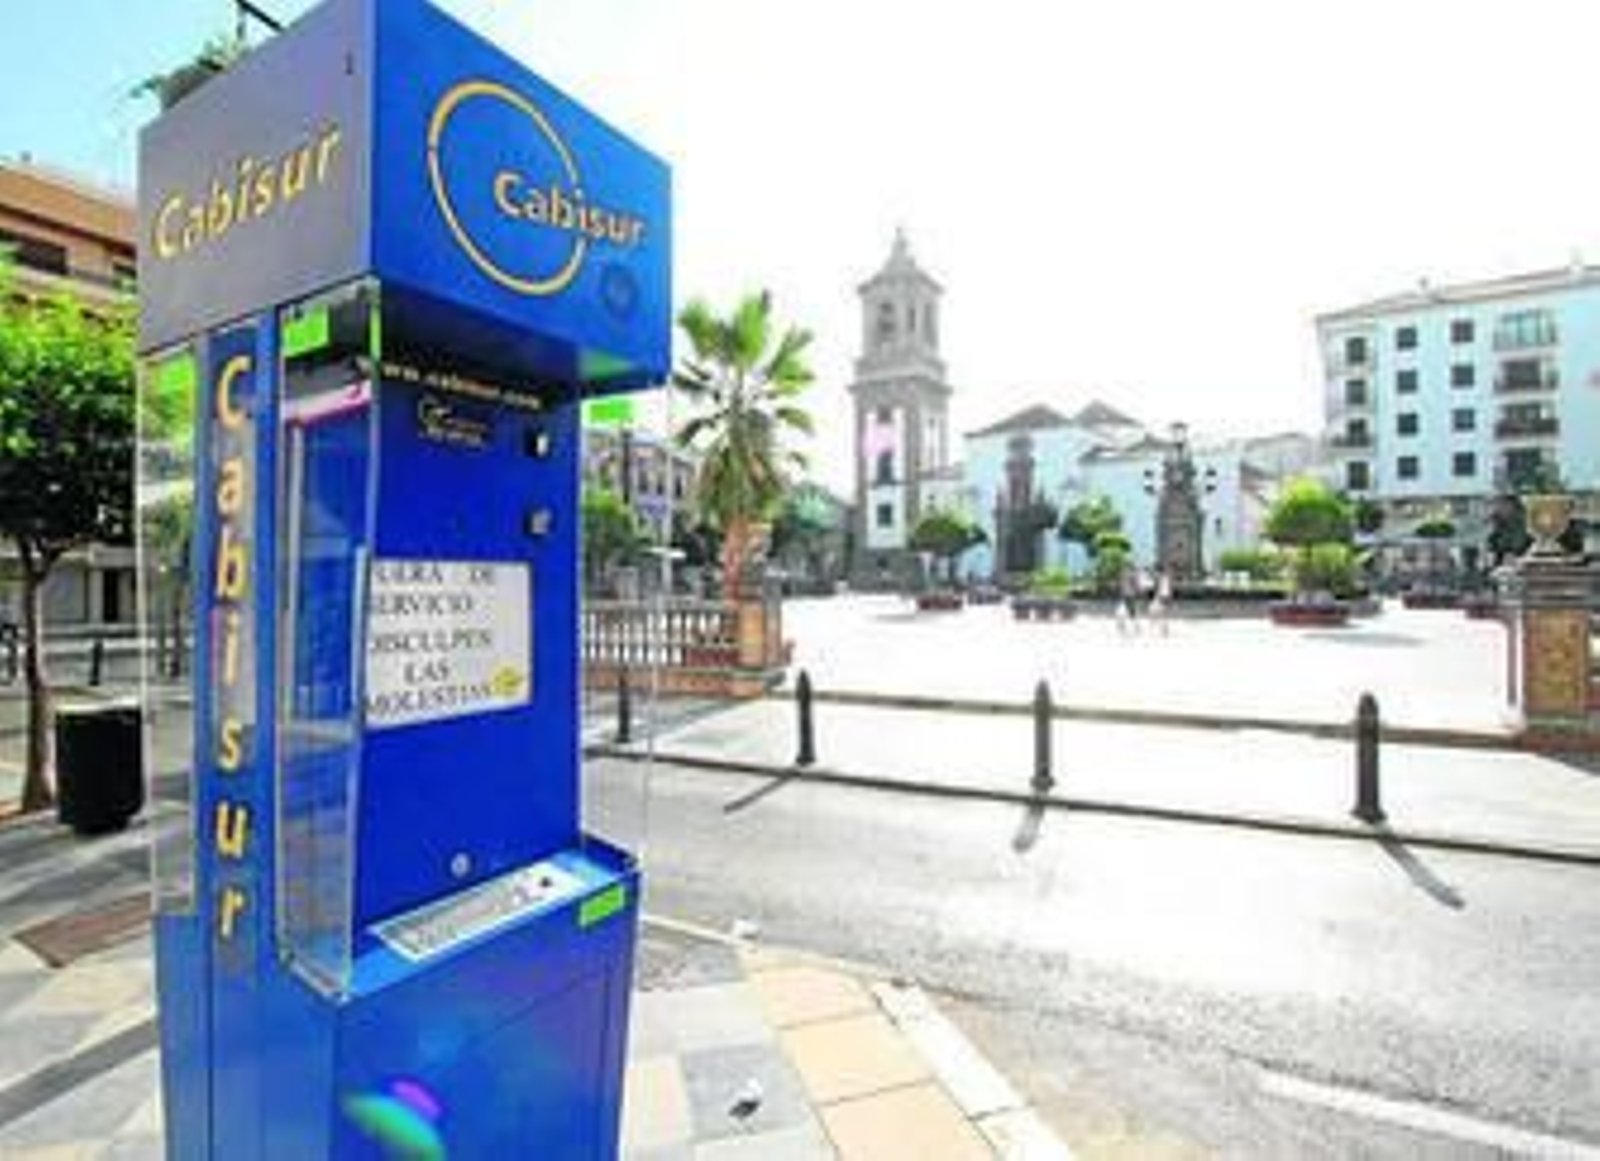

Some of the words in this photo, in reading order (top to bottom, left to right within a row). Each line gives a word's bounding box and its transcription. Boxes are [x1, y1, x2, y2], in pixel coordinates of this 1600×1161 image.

[152, 122, 341, 258] Cabisur
[493, 171, 646, 244] Cabisur
[373, 564, 444, 584] UERA
[371, 593, 474, 616] ERVICIO
[214, 356, 250, 938] Cabisur
[404, 660, 450, 685] LAS
